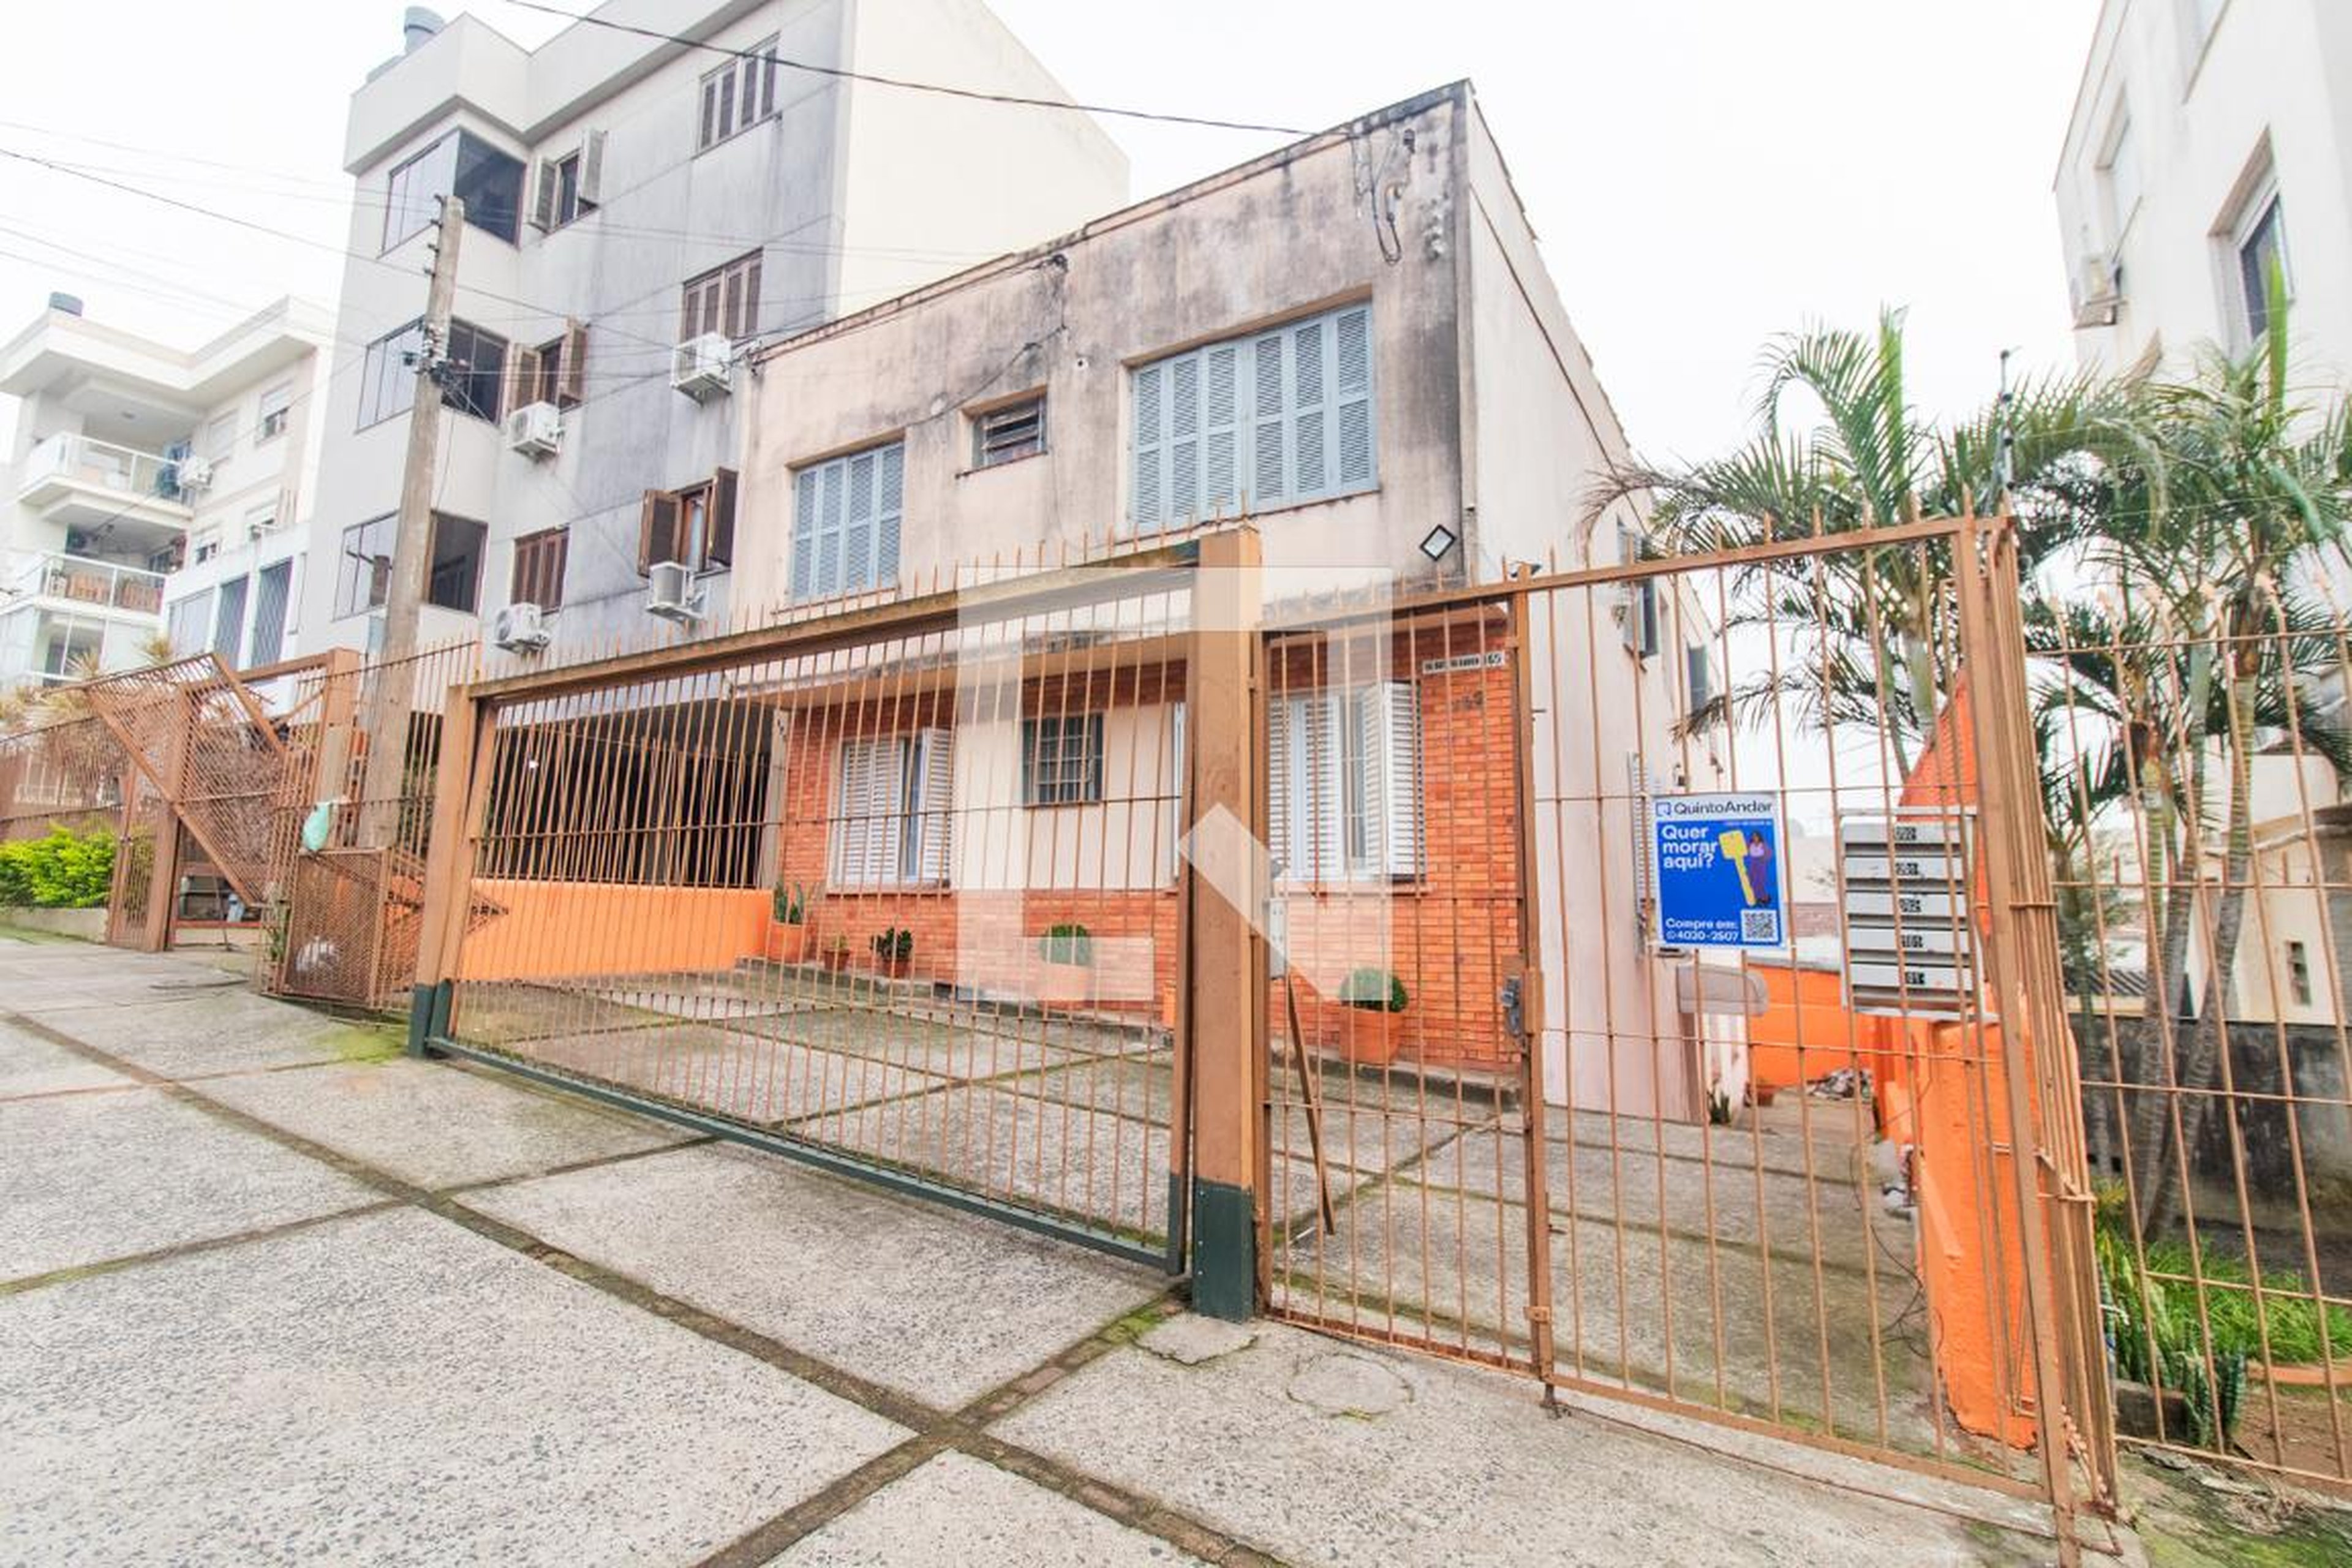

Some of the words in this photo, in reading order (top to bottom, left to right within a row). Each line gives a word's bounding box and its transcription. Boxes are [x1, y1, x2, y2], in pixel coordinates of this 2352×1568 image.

[1673, 801, 1773, 815] QuintoAndar
[1662, 824, 1709, 840] Quer
[1662, 842, 1718, 854] morar
[1663, 853, 1715, 872] aqui?
[1665, 918, 1714, 931] Compre
